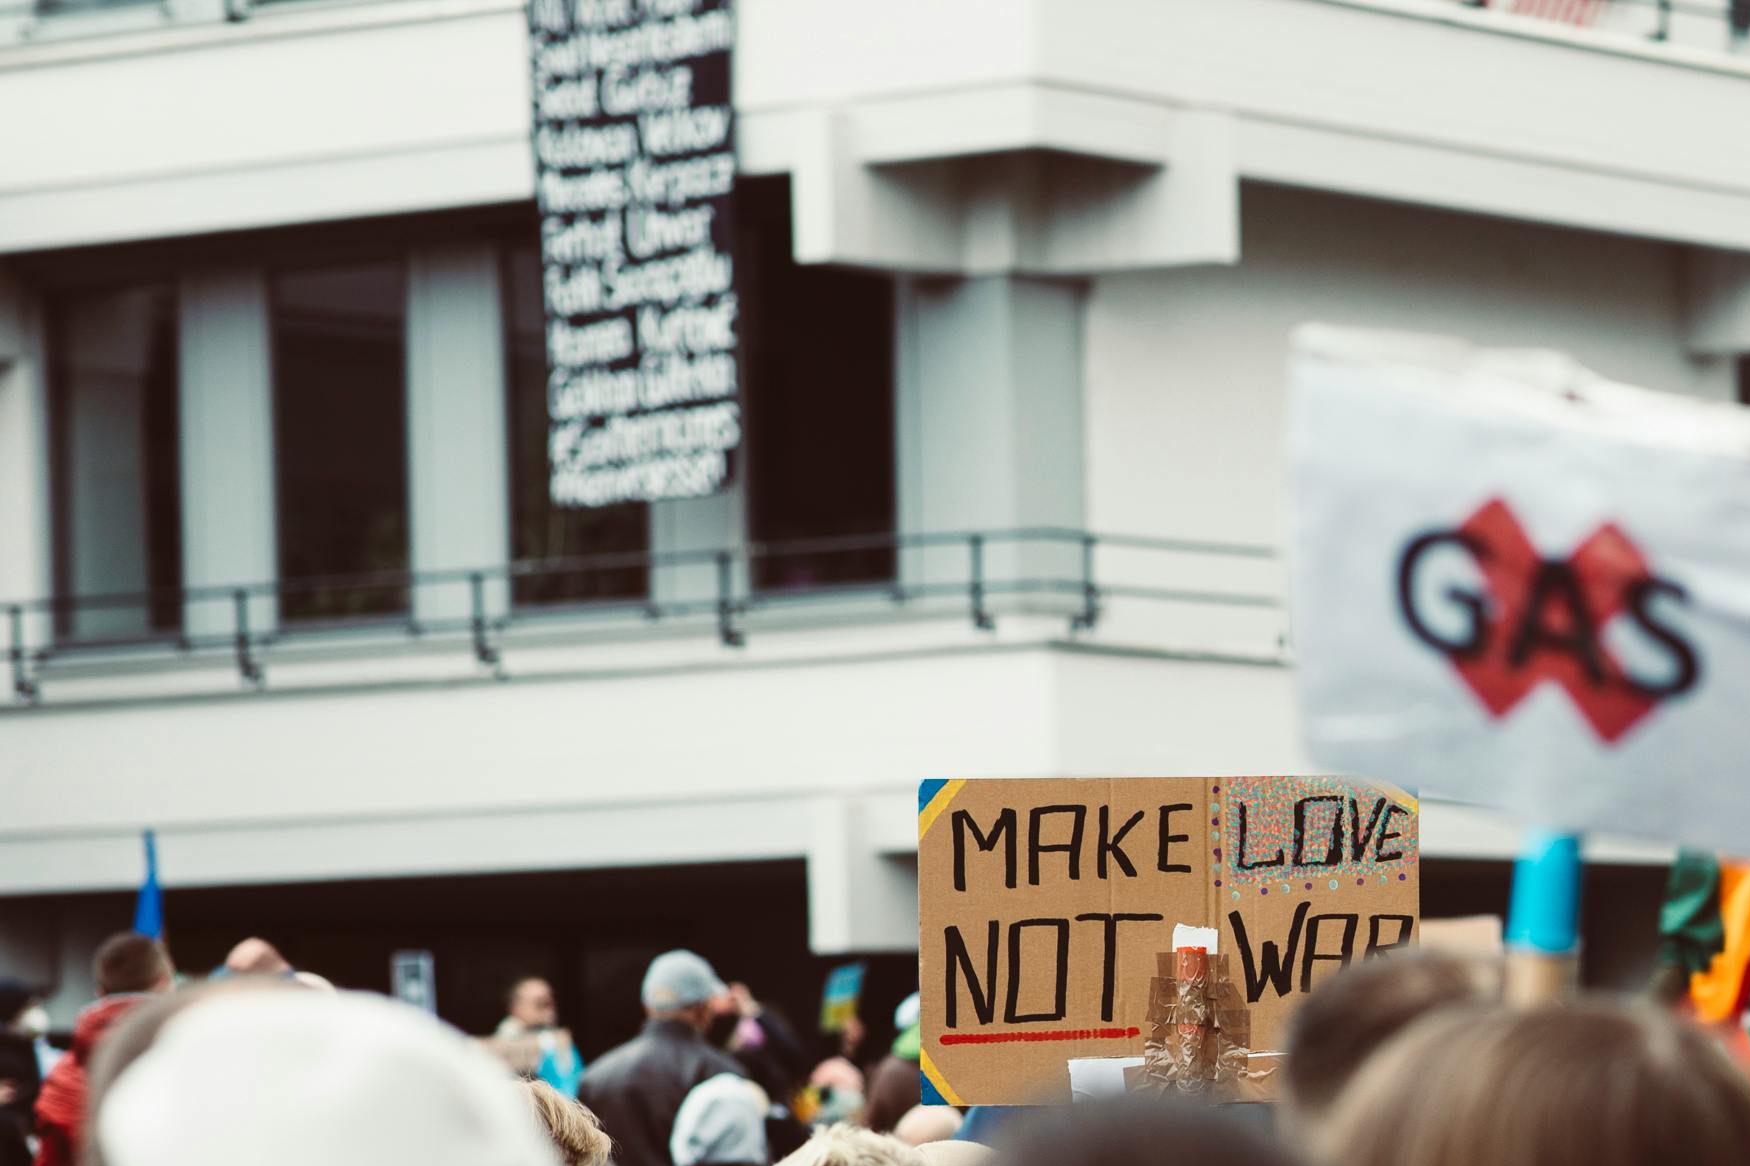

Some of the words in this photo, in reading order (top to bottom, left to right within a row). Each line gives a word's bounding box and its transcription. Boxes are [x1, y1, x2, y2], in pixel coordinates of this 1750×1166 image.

[1394, 526, 1704, 704] GAS
[951, 803, 1194, 892] MAKE
[1233, 794, 1409, 871] LOVE
[944, 912, 1165, 1029] NOT
